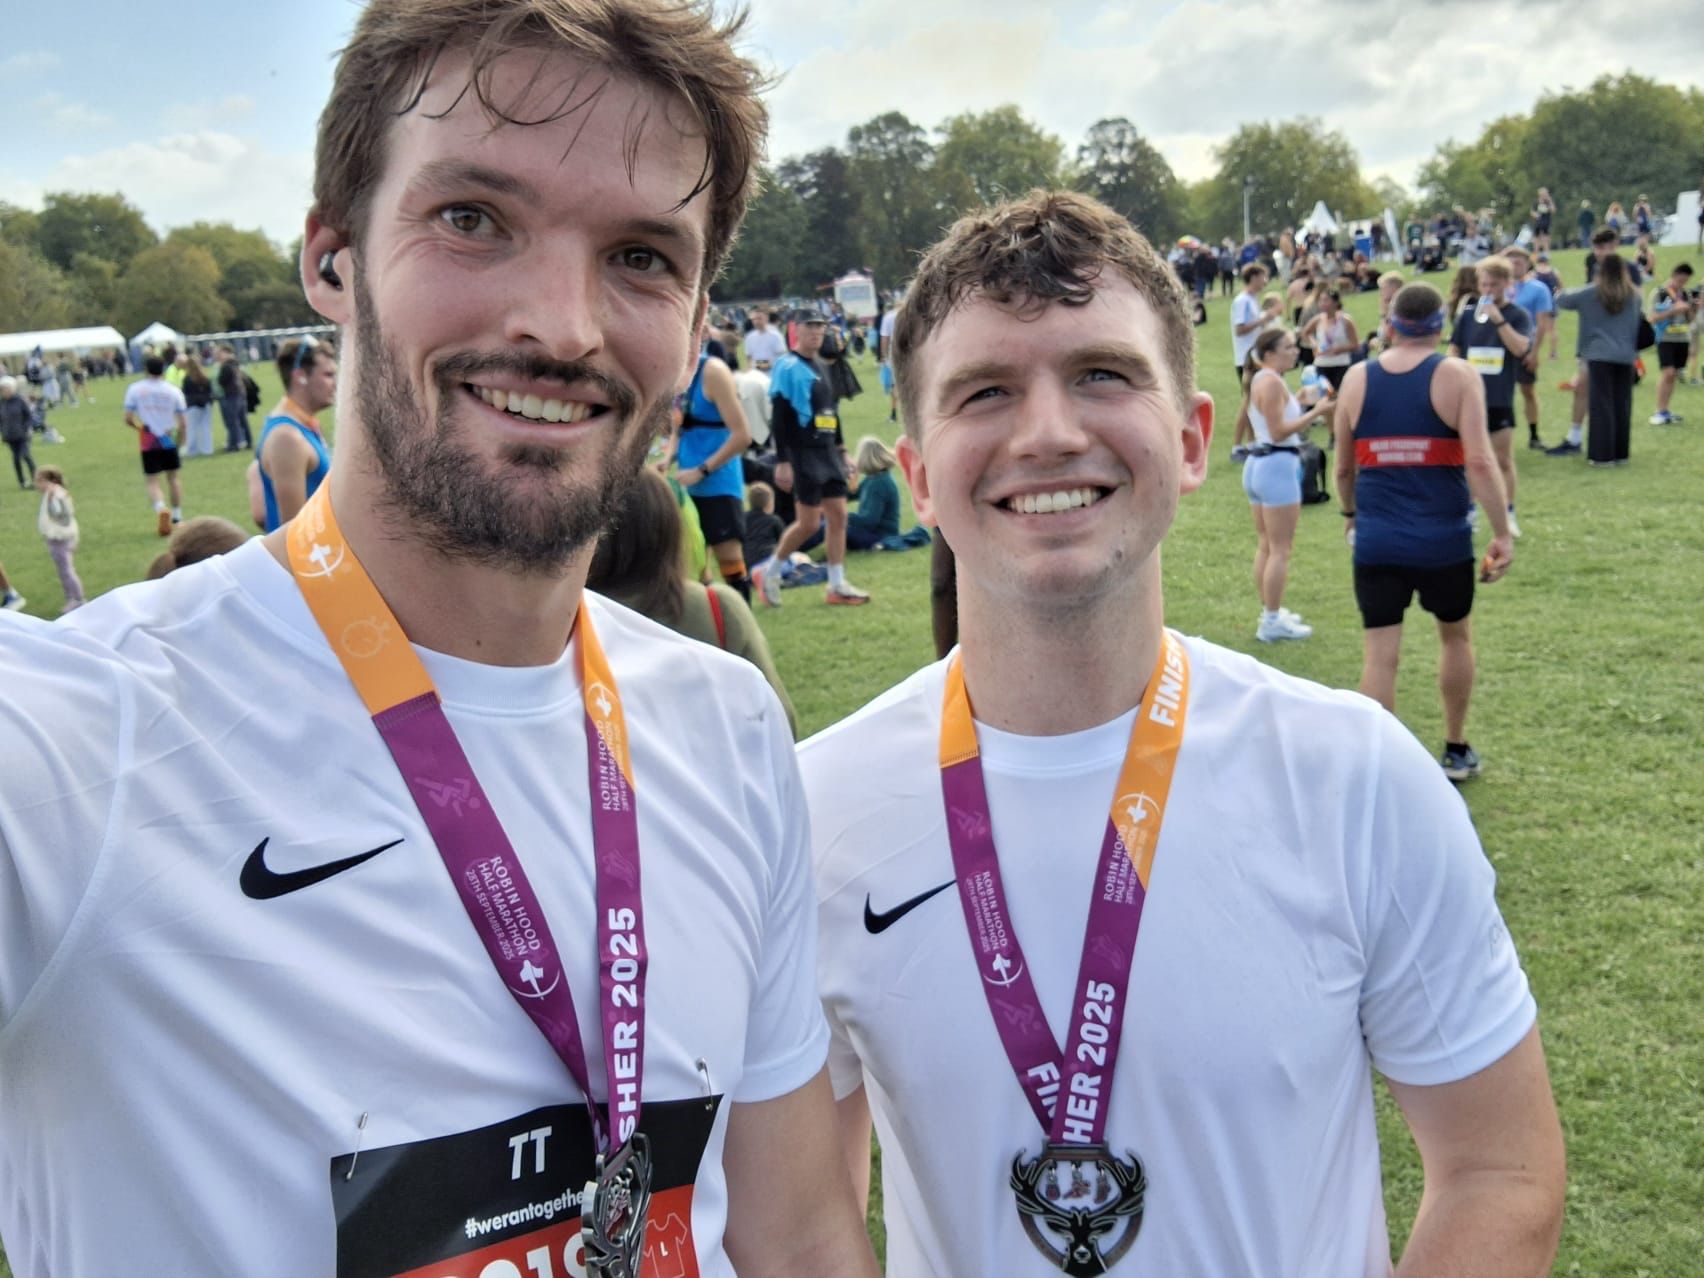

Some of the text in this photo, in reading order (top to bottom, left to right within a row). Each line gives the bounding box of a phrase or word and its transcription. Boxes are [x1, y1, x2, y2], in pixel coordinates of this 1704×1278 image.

[599, 764, 613, 811] ROBIN
[610, 784, 621, 812] HALF
[1103, 824, 1128, 901] ROBIN HOOD
[1113, 879, 1126, 903] HALF
[466, 869, 516, 961] 28TH SEPTEMBER 2025
[478, 862, 529, 956] HALF MARATHON
[490, 856, 541, 950] ROBIN HOOD
[974, 874, 1000, 951] HALF MARATHON
[982, 871, 1008, 947] ROBIN HOOD
[608, 907, 640, 1008] 2025
[1076, 980, 1116, 1067] 2025
[508, 1125, 552, 1181] TT
[464, 1187, 584, 1239] #werantogethe
[660, 1241, 669, 1257] L
